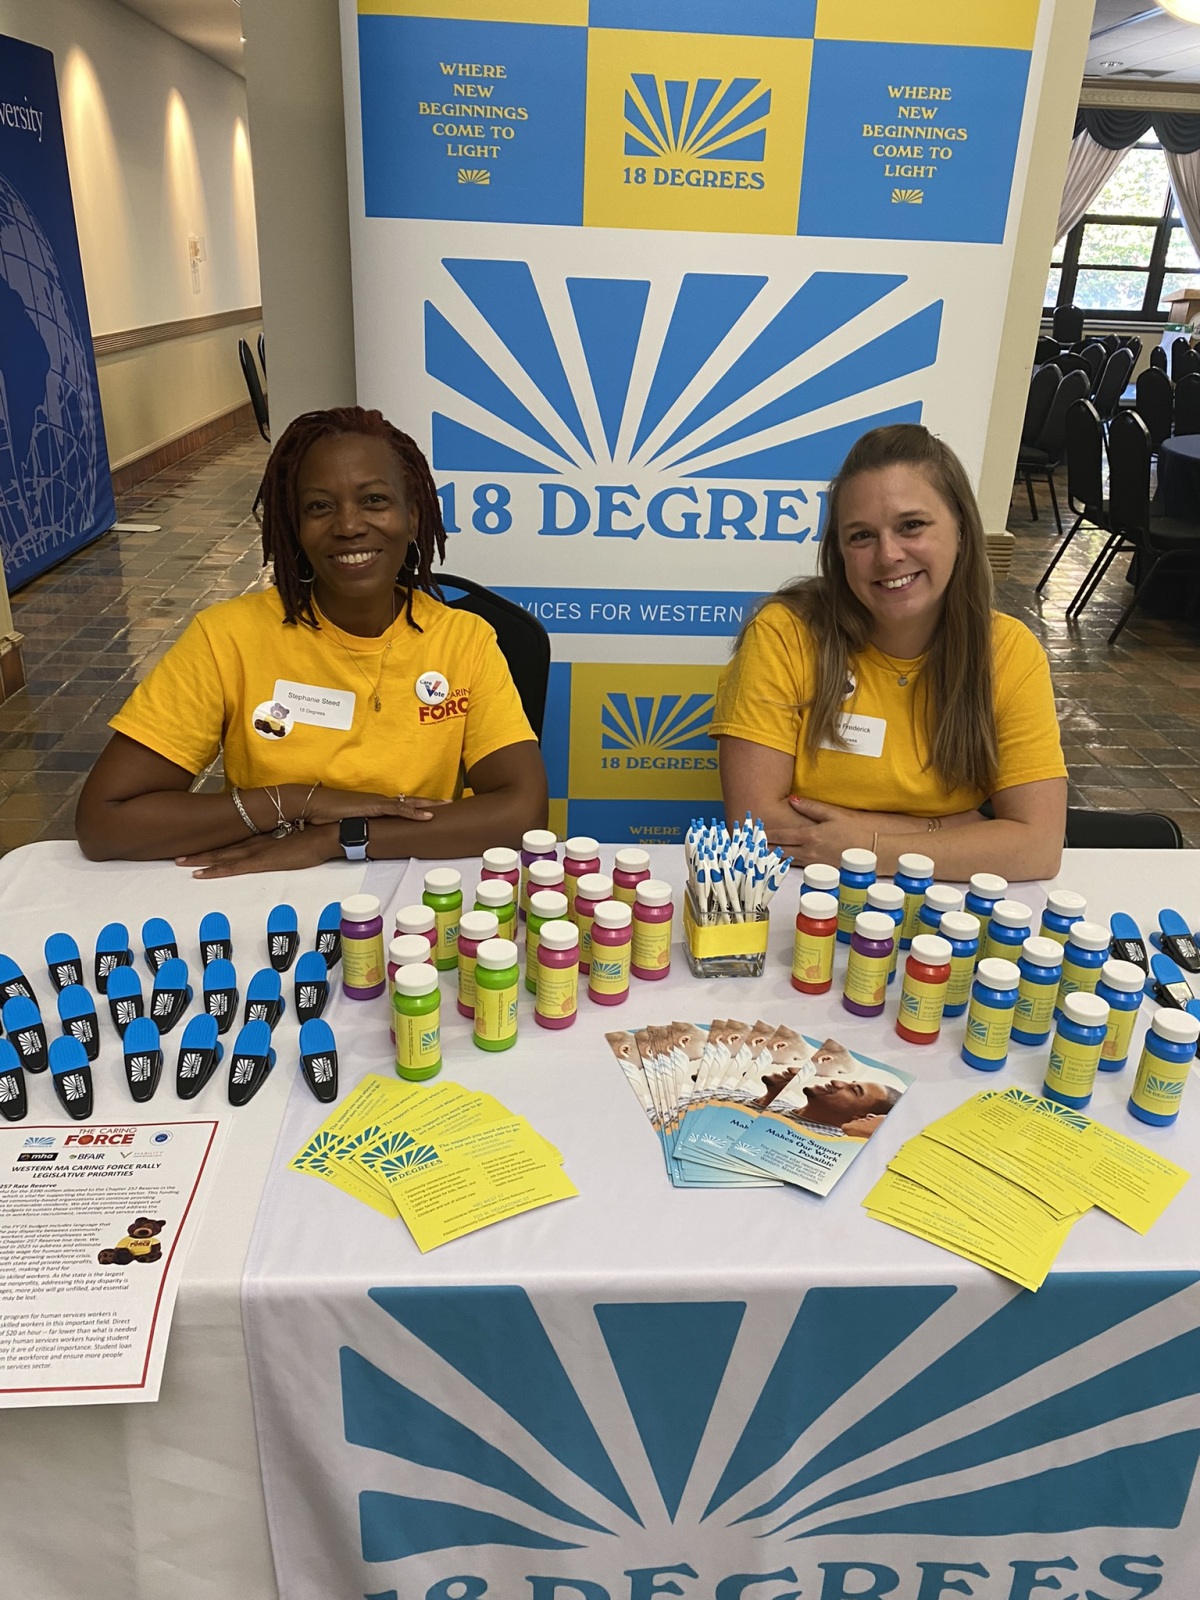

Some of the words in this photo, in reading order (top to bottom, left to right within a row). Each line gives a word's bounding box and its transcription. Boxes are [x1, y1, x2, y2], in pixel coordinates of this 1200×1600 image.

[439, 62, 507, 78] WHERE
[453, 83, 494, 98] NEW
[888, 85, 952, 100] WHERE
[0, 96, 42, 142] versity
[418, 102, 528, 120] BEGINNINGS
[898, 106, 938, 119] NEW
[432, 122, 486, 138] COME
[490, 126, 515, 140] TO
[862, 124, 968, 140] BEGINNINGS
[447, 143, 502, 158] LIGHT
[873, 144, 924, 158] COME
[929, 146, 952, 160] TO
[624, 167, 646, 184] 18
[653, 168, 765, 190] DEGREES
[884, 164, 938, 178] LIGHT
[436, 481, 513, 535] 18
[538, 482, 828, 544] DEGRE
[590, 603, 631, 621] FOR
[640, 604, 743, 623] WESTERN
[424, 680, 445, 698] Vote
[288, 692, 320, 703] Stephanie
[322, 698, 341, 707] Steed
[842, 723, 871, 734] Frederick
[601, 756, 620, 769] 18
[626, 756, 718, 770] DEGREES
[629, 826, 681, 835] WHERE
[64, 1134, 135, 1146] FORCE
[766, 1128, 794, 1144] Makes
[796, 1141, 813, 1151] Our
[815, 1148, 838, 1163] Work
[787, 1129, 807, 1142] Your
[808, 1139, 842, 1158] Support
[798, 1149, 834, 1167] Possible
[398, 1159, 443, 1179] DEGREES
